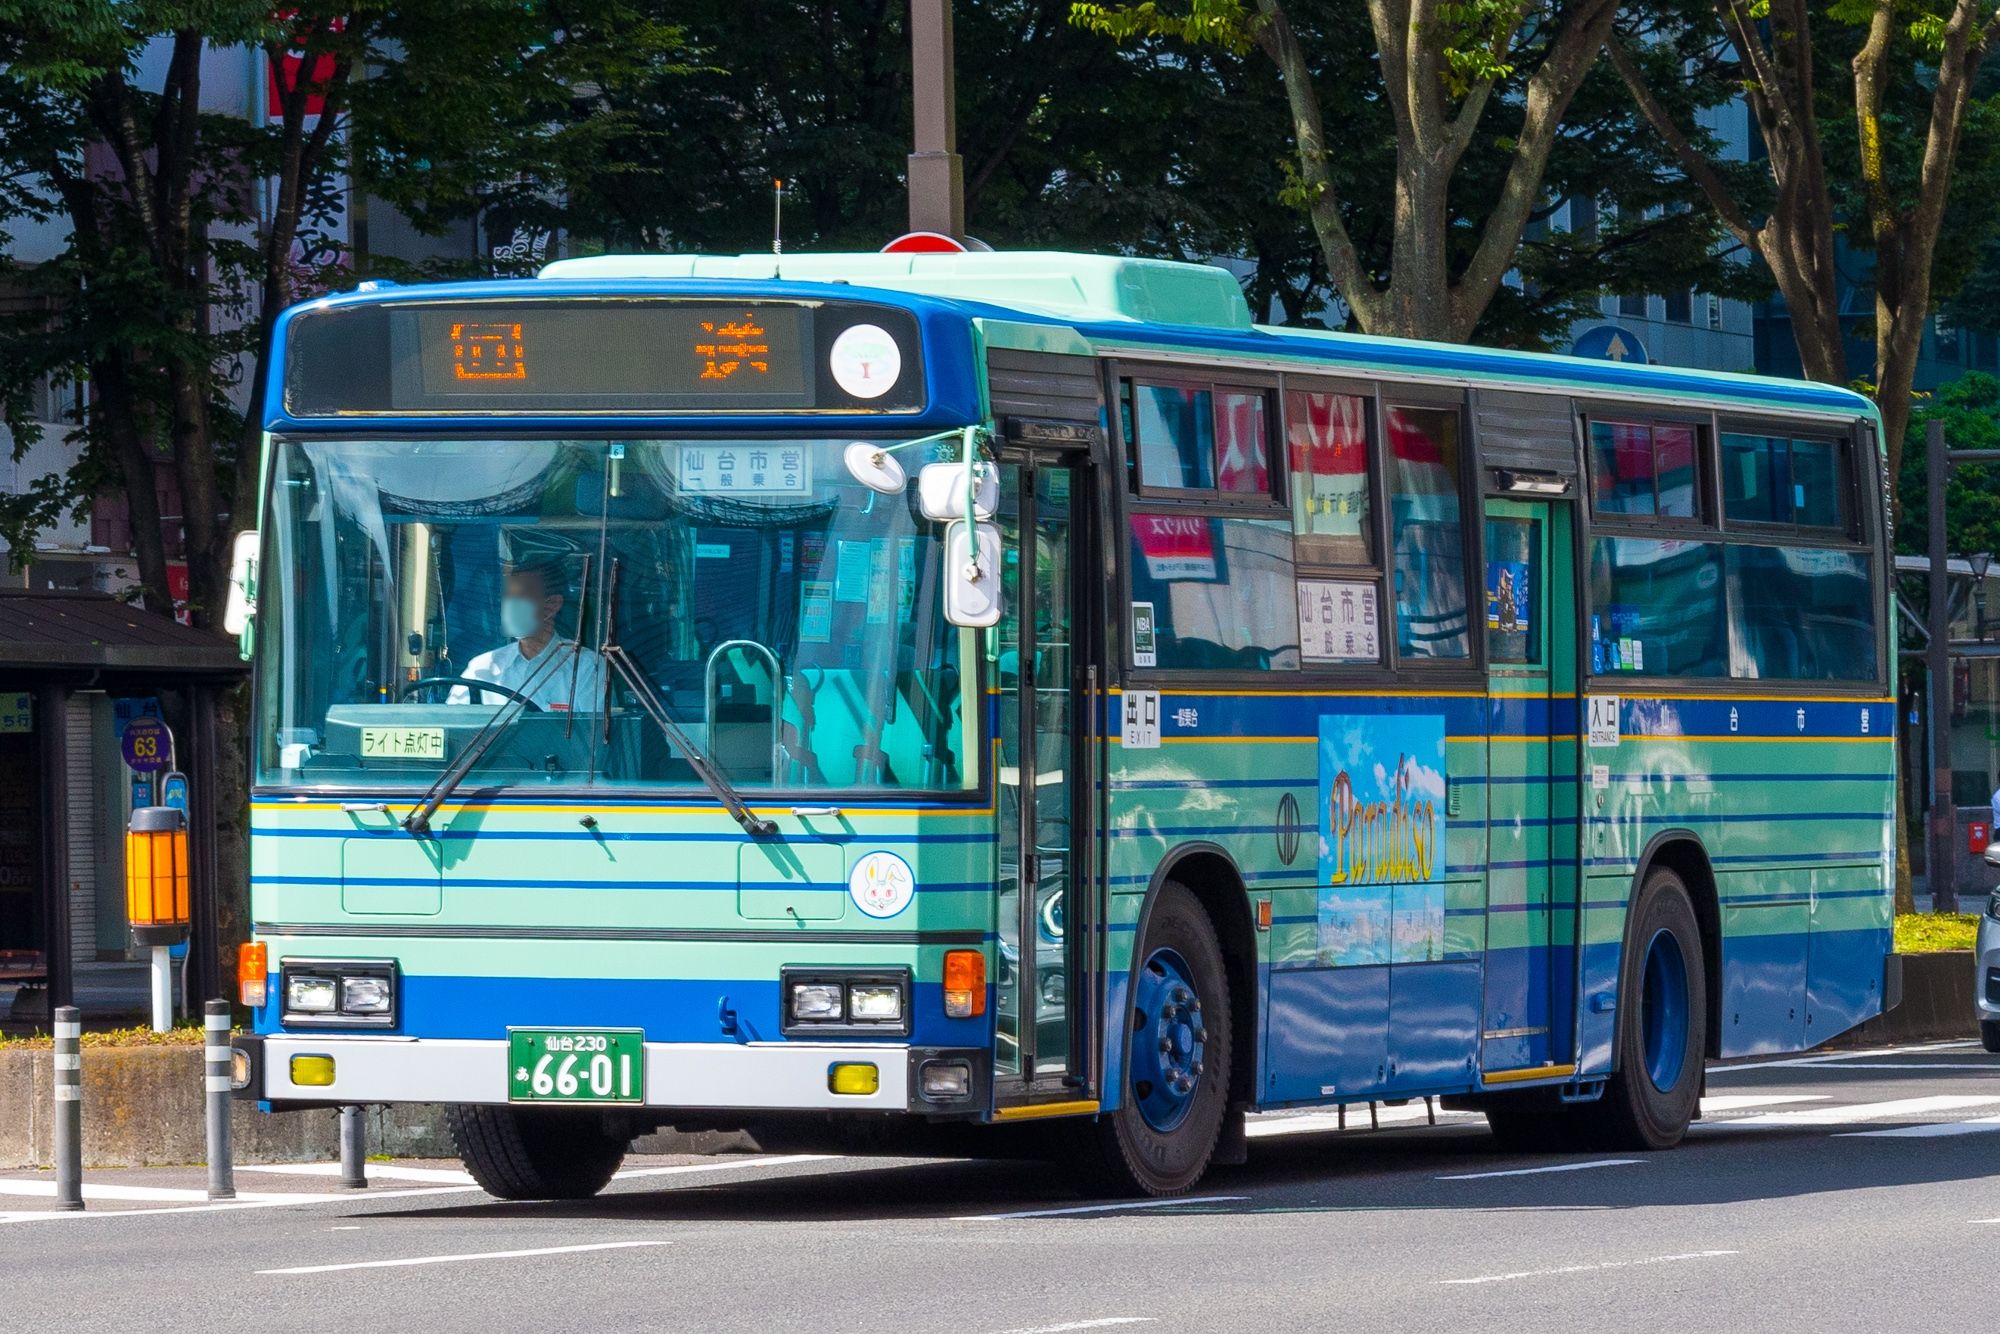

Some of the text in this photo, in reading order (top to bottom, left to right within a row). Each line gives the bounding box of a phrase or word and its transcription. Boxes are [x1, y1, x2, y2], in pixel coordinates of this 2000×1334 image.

[685, 450, 800, 471] 仙台市営
[689, 473, 796, 486] 一般乗合
[1299, 585, 1375, 625] 仙台市営
[1127, 694, 1156, 727] 出口
[1592, 700, 1616, 727] 入口
[134, 737, 157, 757] 63
[365, 731, 442, 754] ライト点灯中
[1130, 731, 1152, 744] EXIT
[1592, 731, 1616, 743] ENTRANCE
[1331, 752, 1435, 884] Paradiso
[544, 1036, 607, 1051] 仙台230
[515, 1053, 631, 1096] あ 66-01
